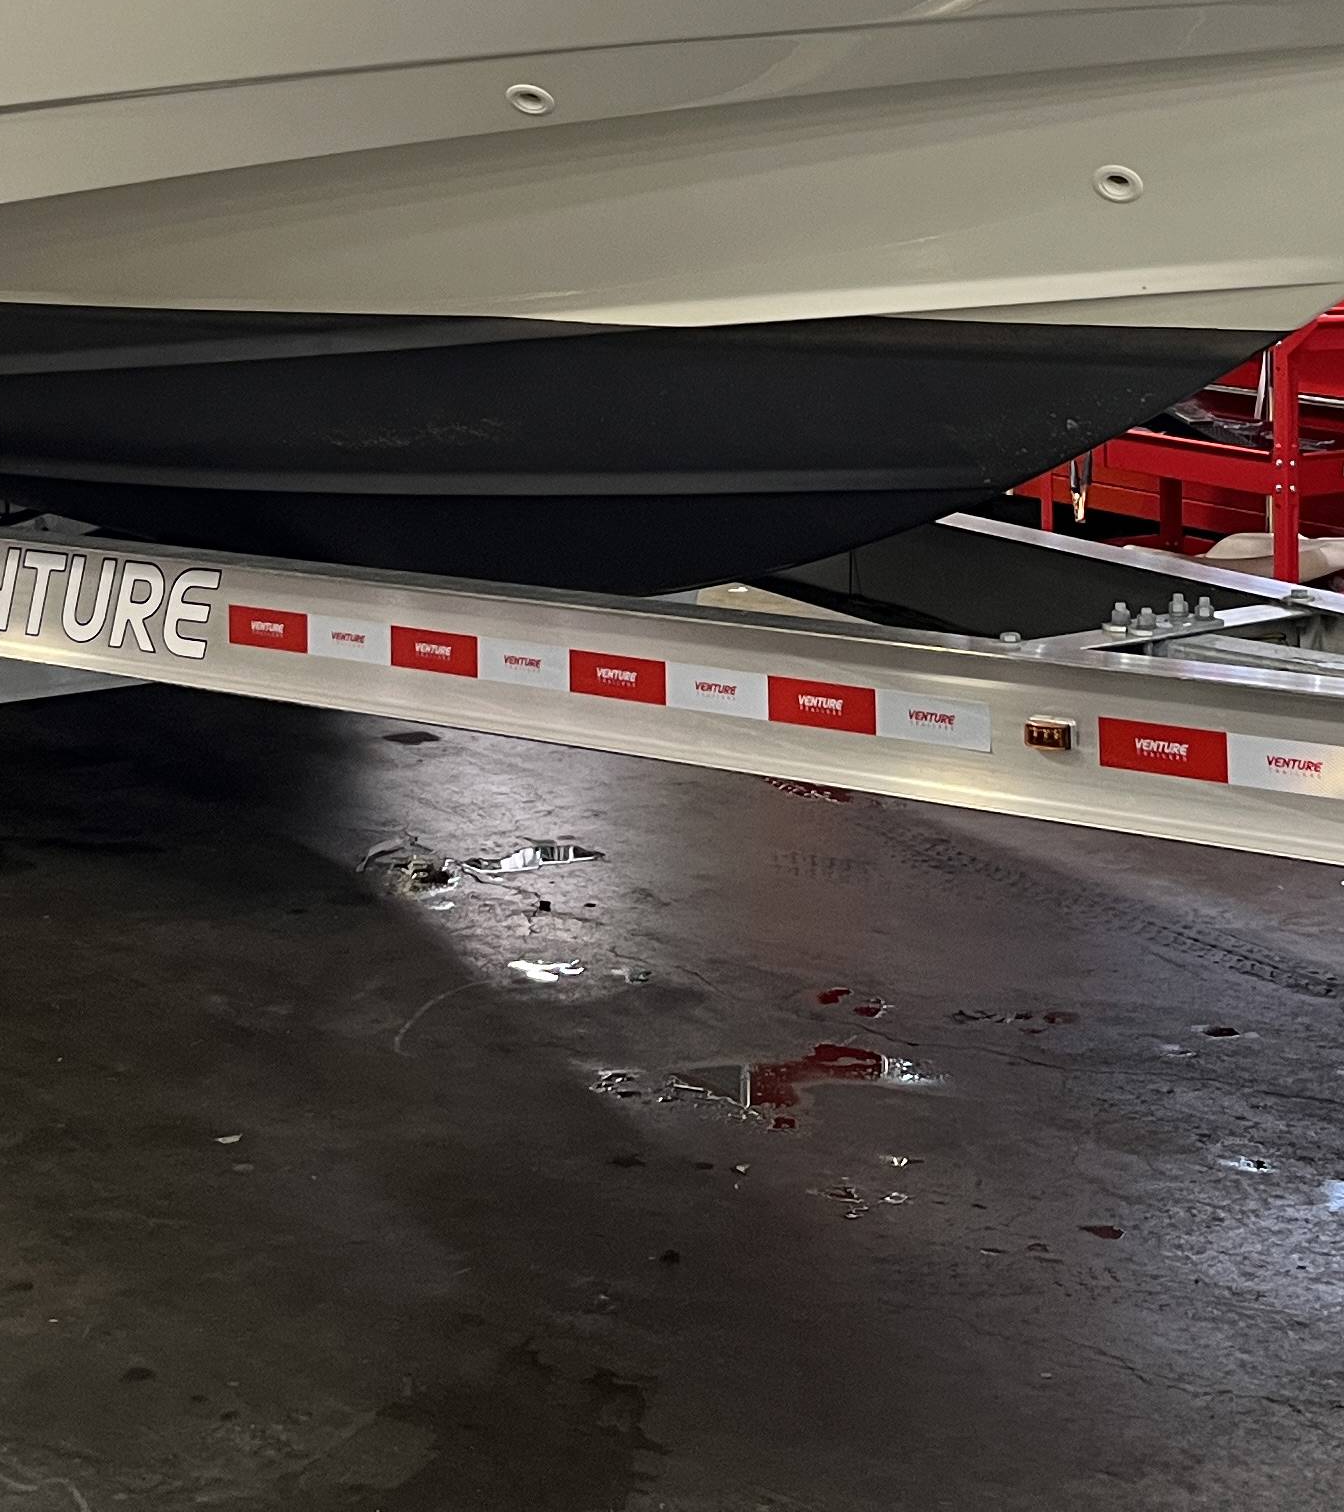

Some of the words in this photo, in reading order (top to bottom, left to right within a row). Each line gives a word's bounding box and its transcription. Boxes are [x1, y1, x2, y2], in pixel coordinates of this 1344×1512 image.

[251, 620, 285, 634] VENTURE
[331, 631, 366, 644] VENTURE
[415, 642, 452, 656] VENTURE
[504, 655, 542, 669] VENTURE
[596, 667, 637, 682] VENTURE
[695, 681, 737, 696] VENTURE
[798, 695, 843, 711] VENTURE
[909, 709, 955, 726] VENTURE
[1135, 738, 1189, 756] VENTURE
[1266, 755, 1323, 773] VENTURE
